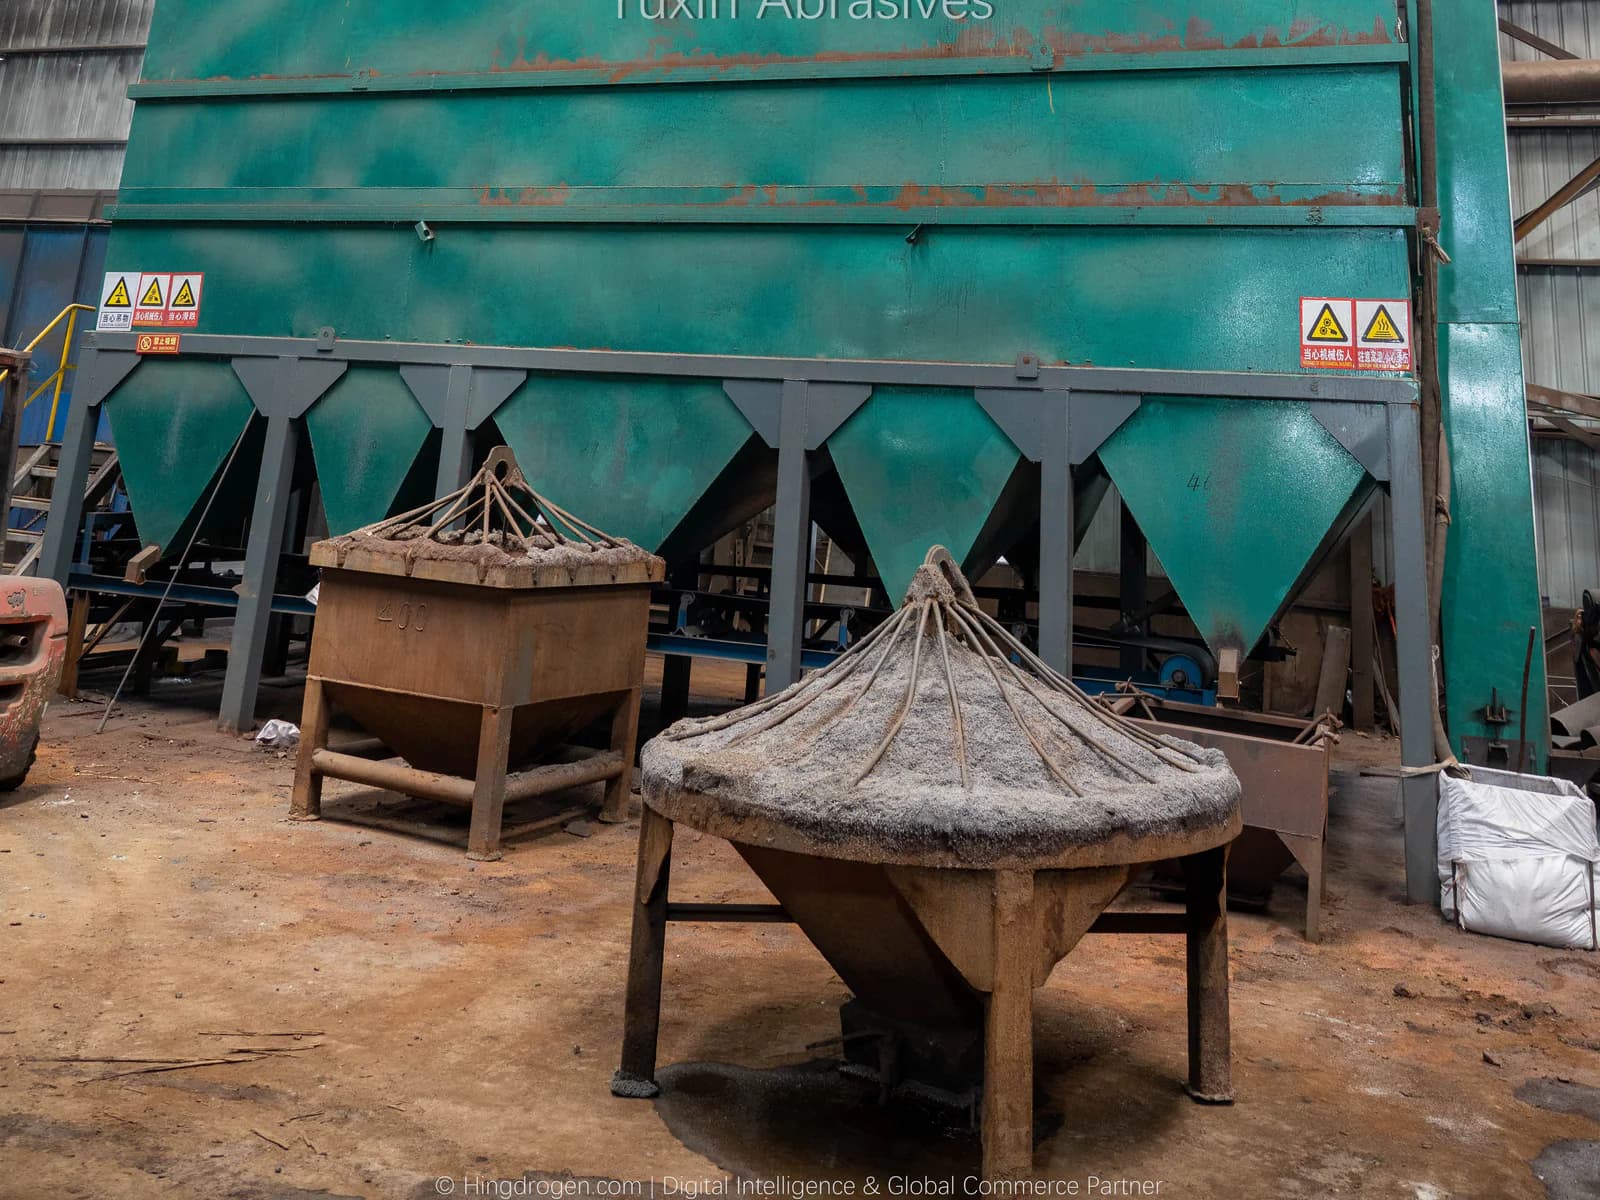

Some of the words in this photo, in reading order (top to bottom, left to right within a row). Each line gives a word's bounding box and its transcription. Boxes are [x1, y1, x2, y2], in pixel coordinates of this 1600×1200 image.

[1303, 348, 1353, 362] 当心机械伤人
